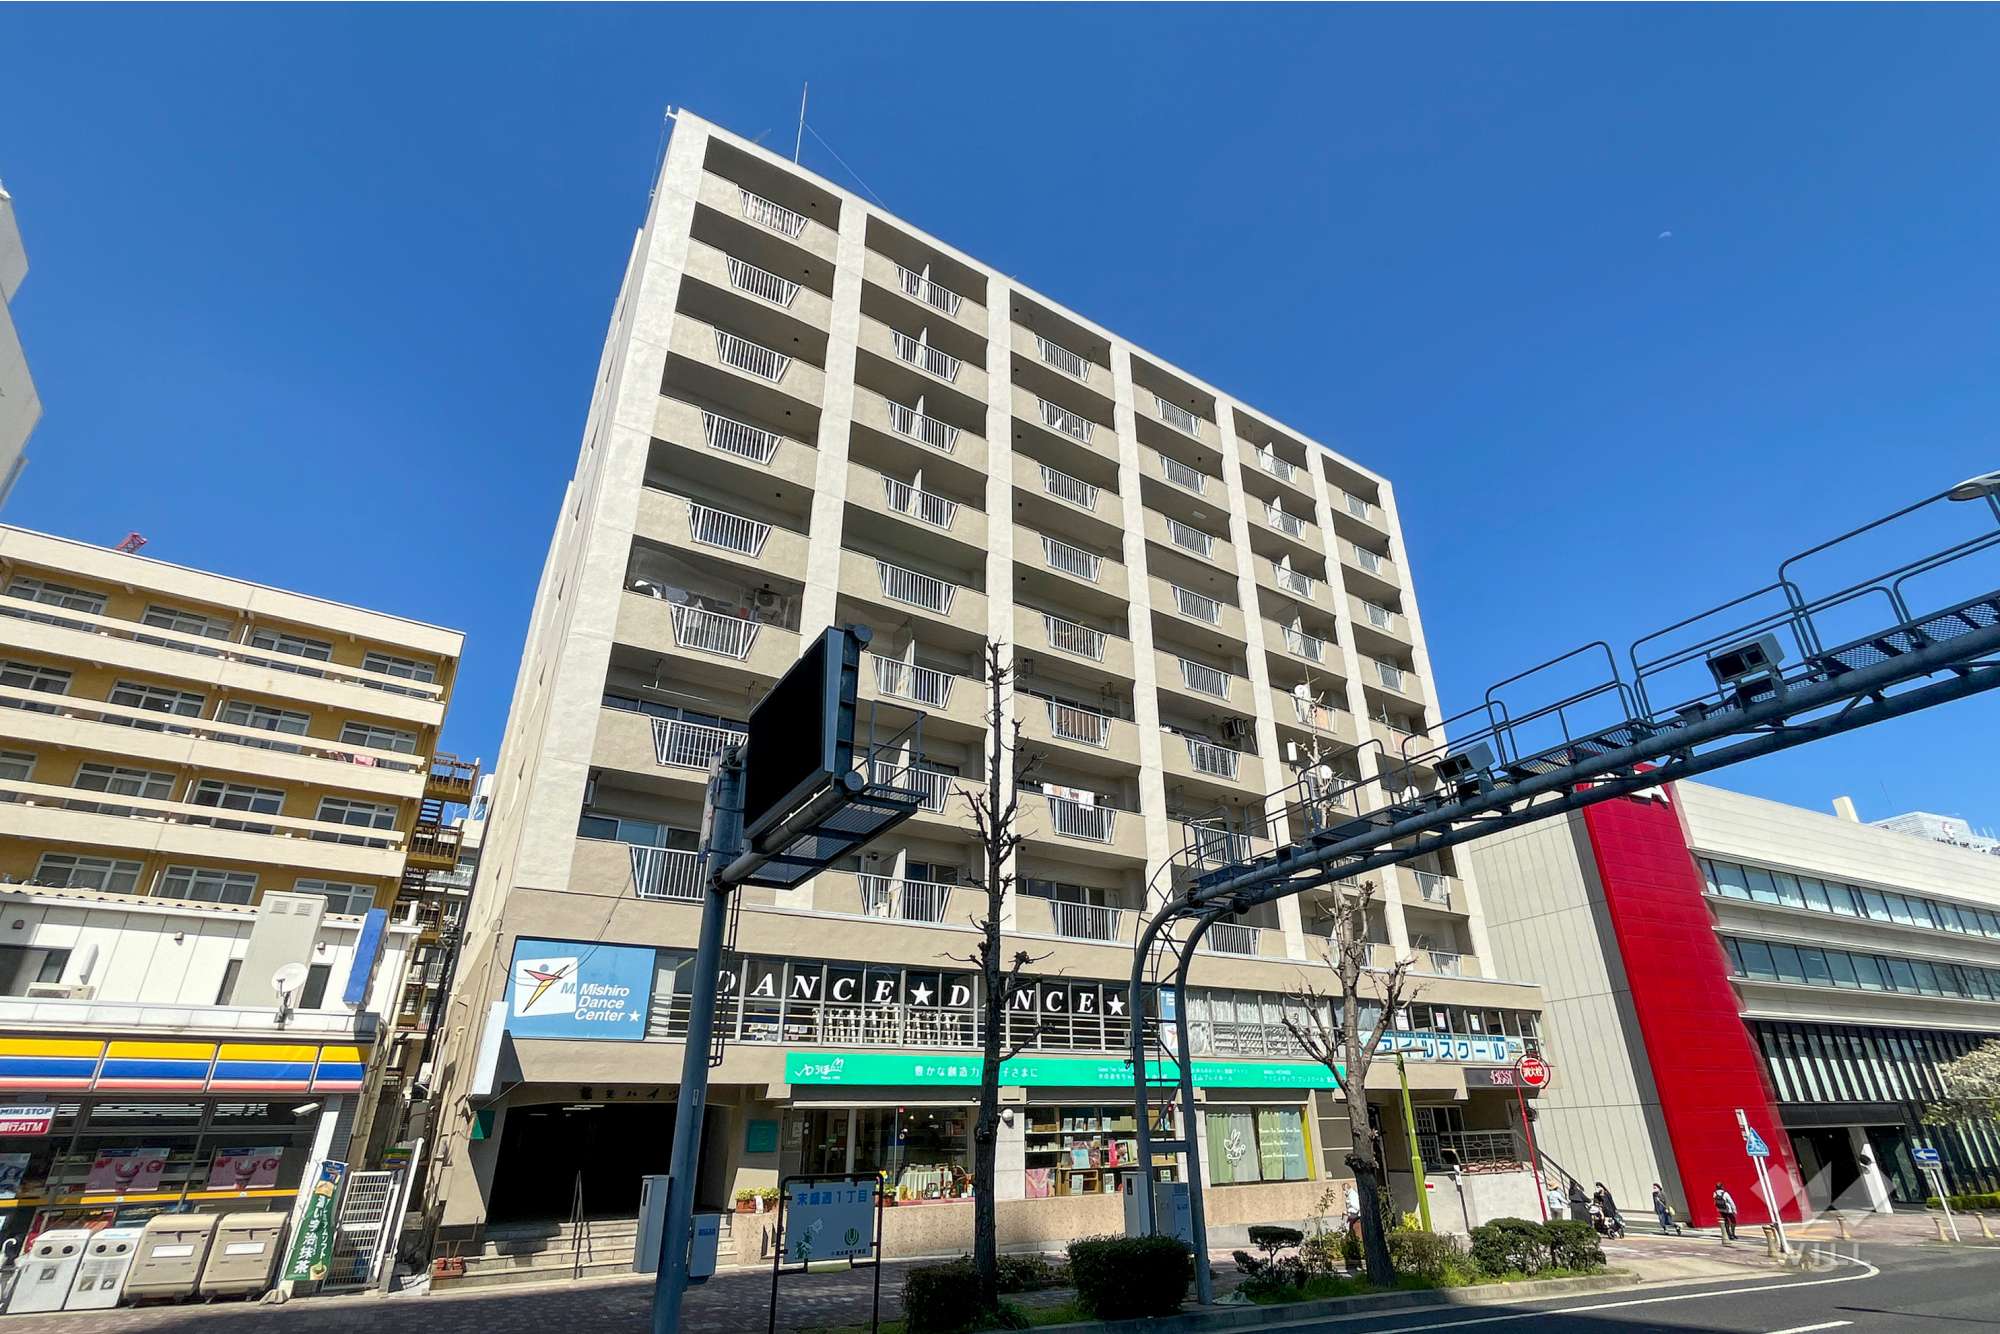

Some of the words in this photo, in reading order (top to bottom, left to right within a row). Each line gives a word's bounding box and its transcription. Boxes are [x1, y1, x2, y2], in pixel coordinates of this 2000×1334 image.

[579, 983, 630, 997] Mishiro
[578, 996, 625, 1009] Dance
[948, 985, 1094, 1013] DNCE
[574, 1009, 626, 1022] Center
[24, 1108, 52, 1116] STOP
